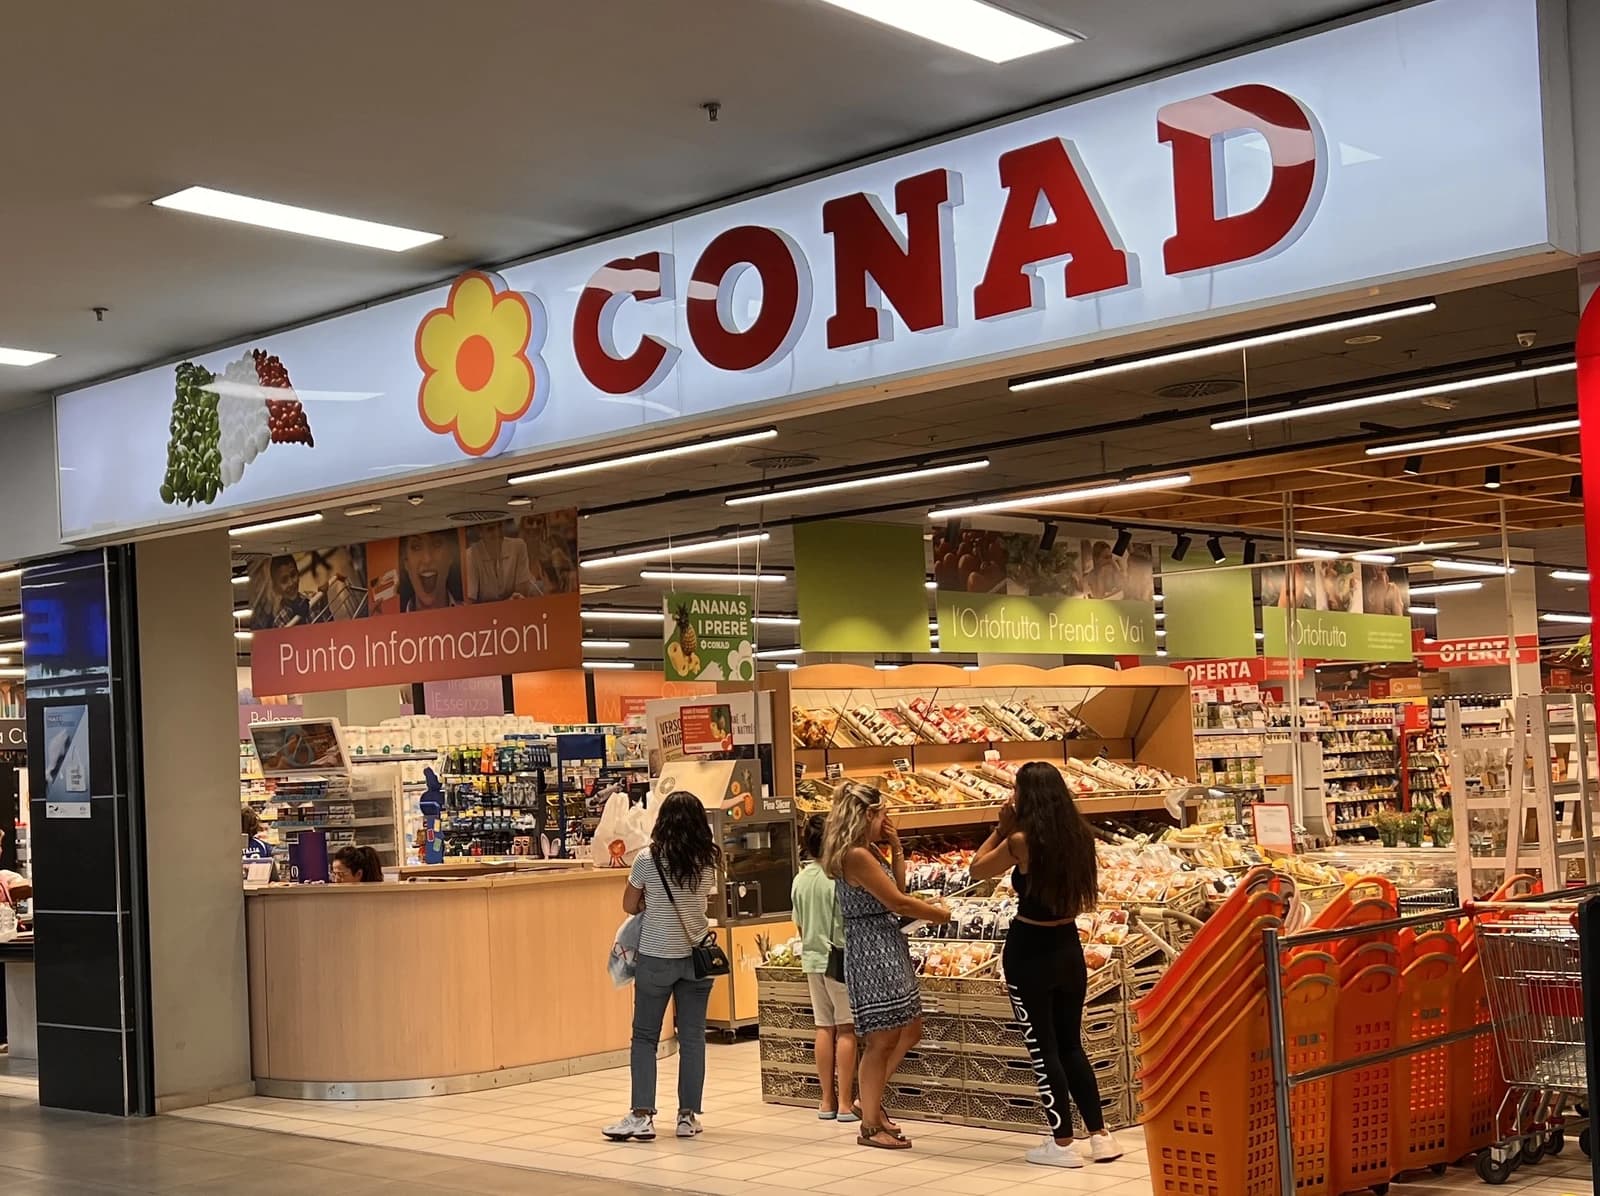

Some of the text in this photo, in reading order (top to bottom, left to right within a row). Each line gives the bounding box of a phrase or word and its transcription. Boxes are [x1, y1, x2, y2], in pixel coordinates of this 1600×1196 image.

[572, 83, 1322, 394] CONAD
[690, 599, 747, 616] ANANAS
[698, 617, 748, 636] I PRERË
[1049, 612, 1099, 643] Prendi
[1104, 624, 1115, 643] e
[1119, 615, 1145, 643] Vai
[279, 612, 549, 676] Punto Informazioni
[707, 641, 730, 650] CONAD
[1183, 661, 1252, 681] OFERTA
